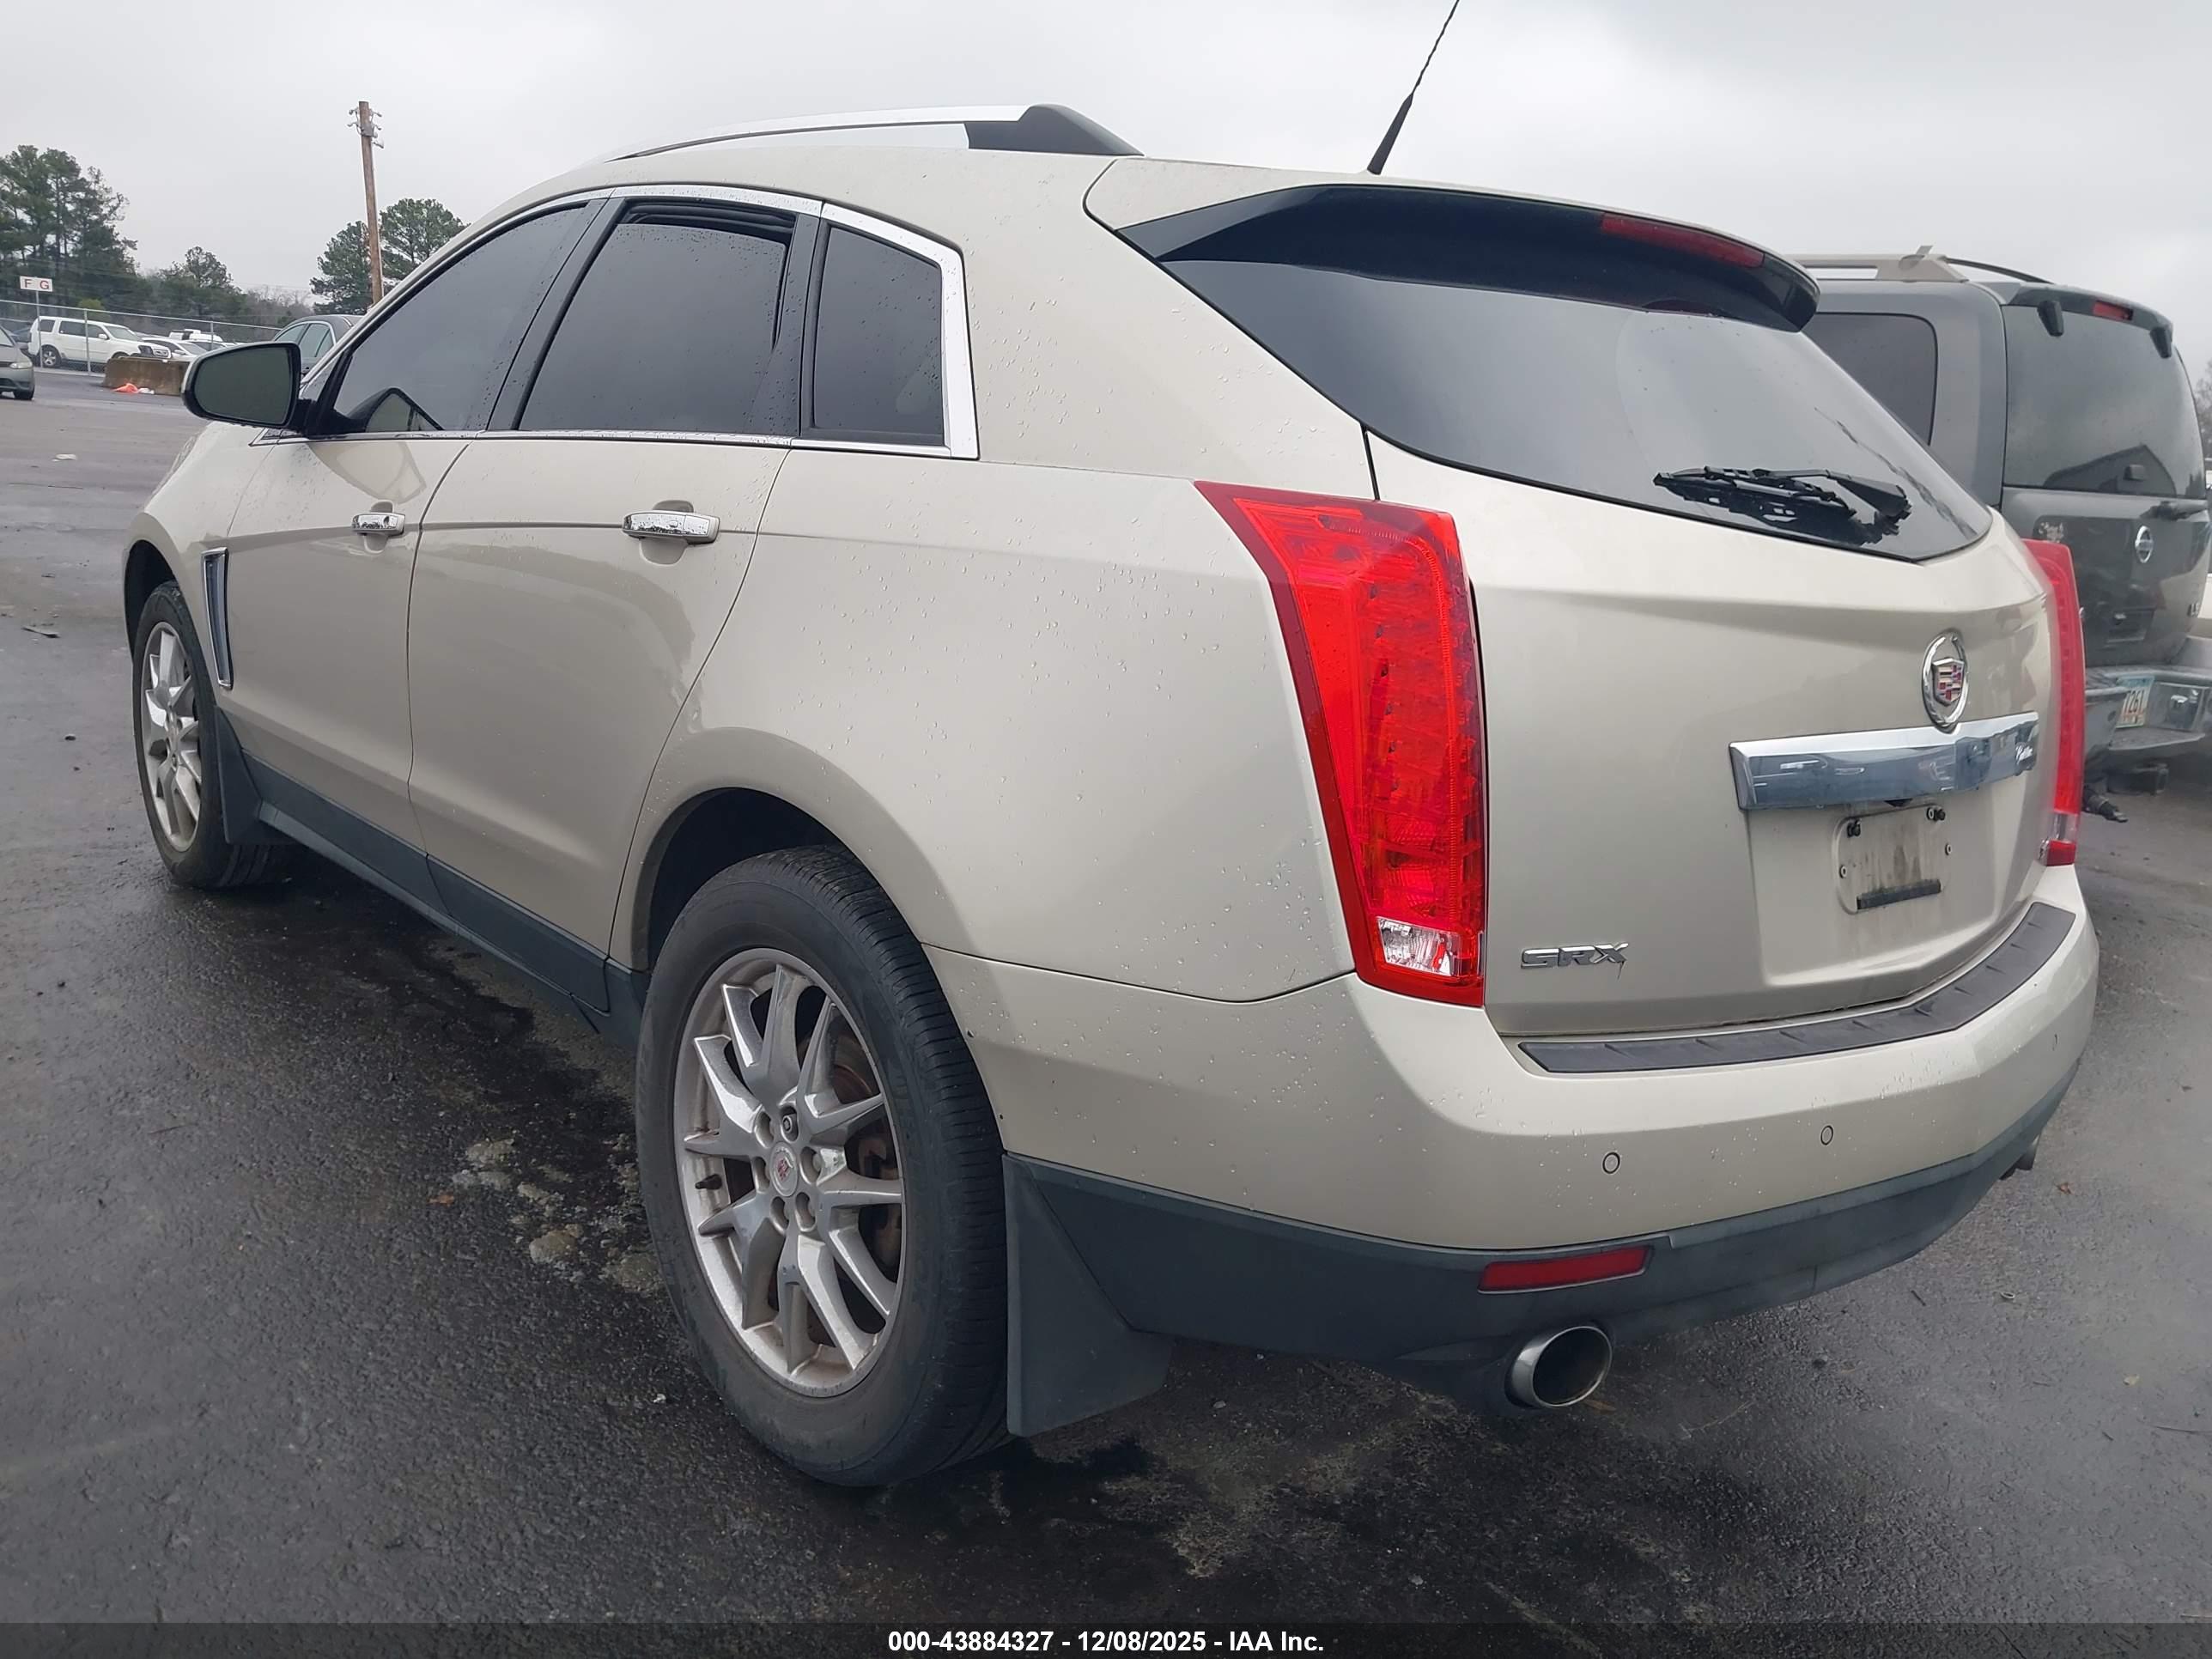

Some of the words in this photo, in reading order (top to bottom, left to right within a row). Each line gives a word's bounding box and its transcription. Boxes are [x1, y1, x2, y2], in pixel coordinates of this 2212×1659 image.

[24, 278, 32, 289] F
[40, 280, 50, 290] G
[1521, 943, 1629, 969] SRX
